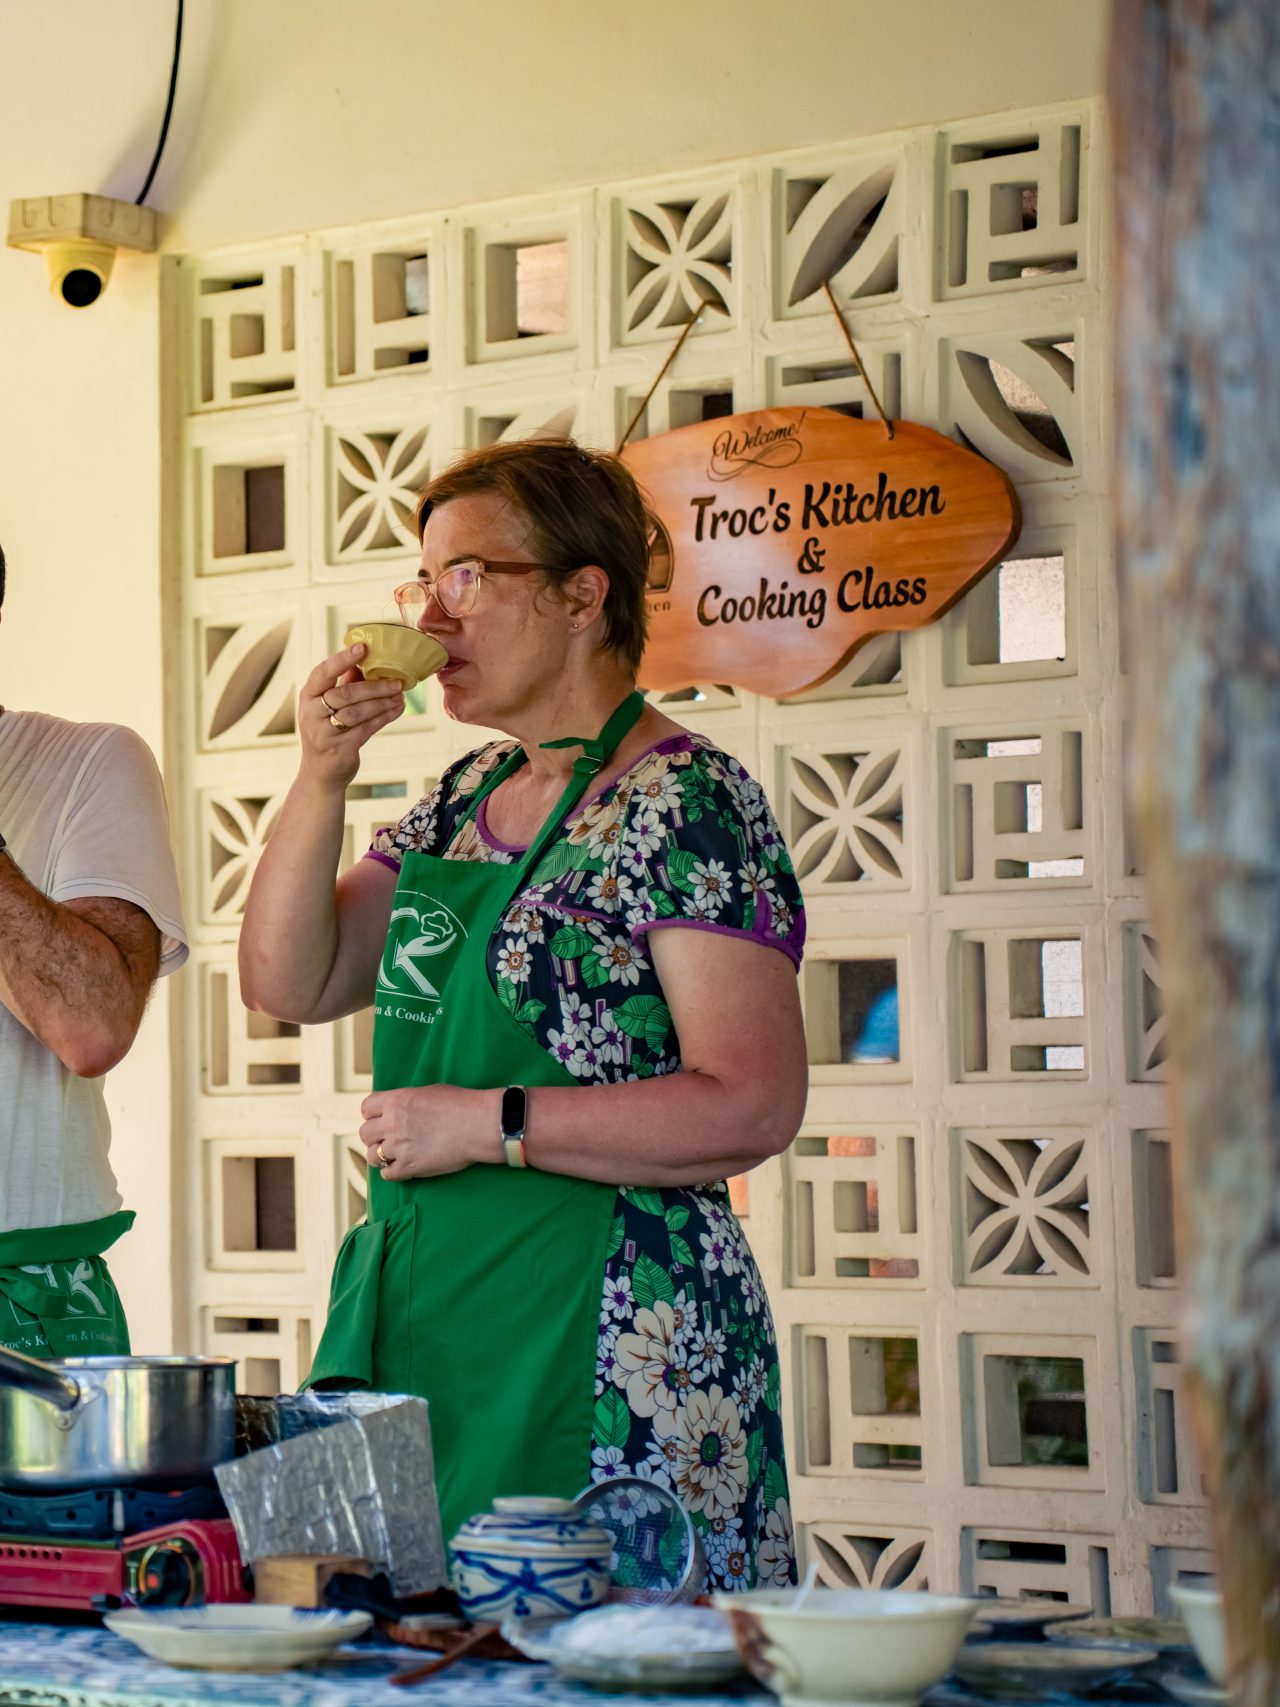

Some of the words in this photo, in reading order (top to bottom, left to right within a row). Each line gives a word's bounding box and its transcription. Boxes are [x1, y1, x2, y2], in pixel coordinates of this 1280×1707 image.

[711, 410, 806, 461] Welcome!
[690, 488, 791, 542] Troc's
[802, 472, 945, 529] Kitchen
[798, 537, 826, 574] &
[697, 577, 827, 628] Cooking
[837, 566, 927, 612] Class
[384, 1005, 393, 1017] &
